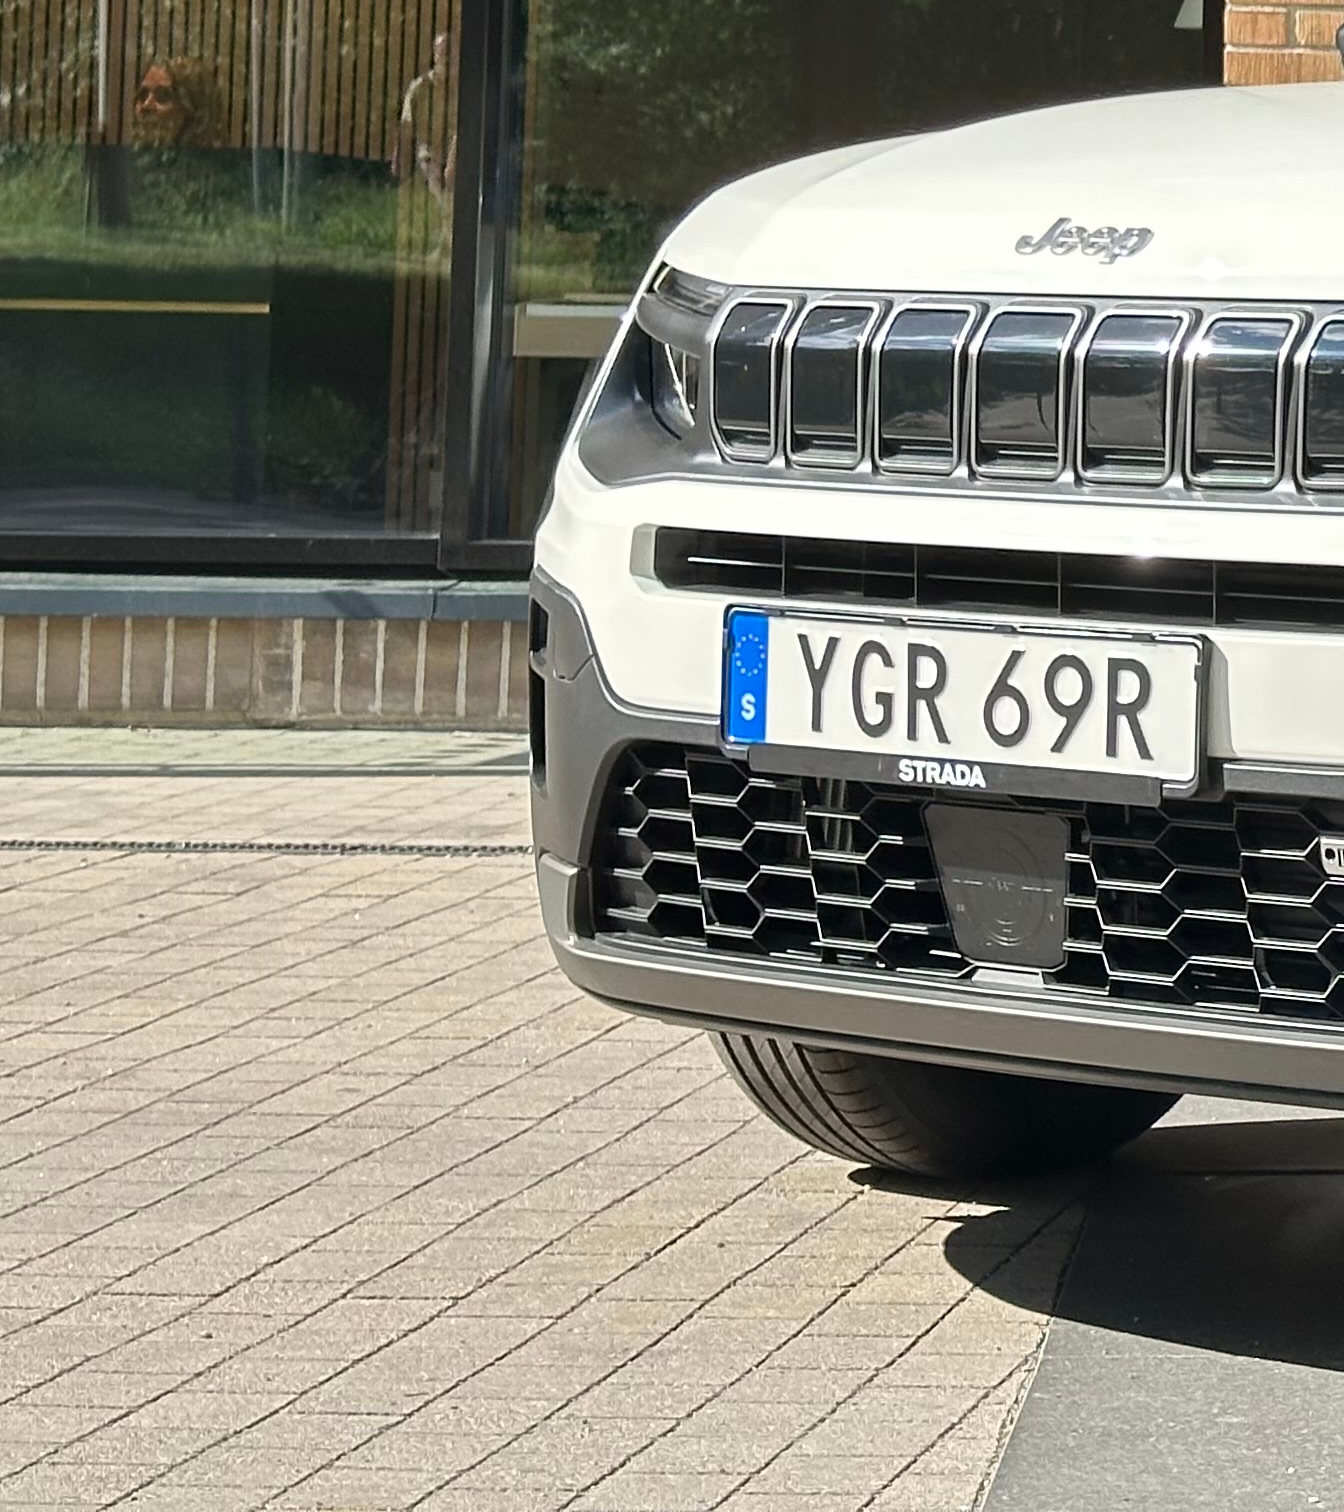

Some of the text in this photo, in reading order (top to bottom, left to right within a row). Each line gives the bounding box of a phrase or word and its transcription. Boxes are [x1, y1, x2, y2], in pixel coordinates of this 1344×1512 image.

[1014, 216, 1155, 265] Jeep
[740, 691, 757, 722] S
[797, 631, 1155, 761] YGR 69R
[898, 758, 987, 789] STRADA
